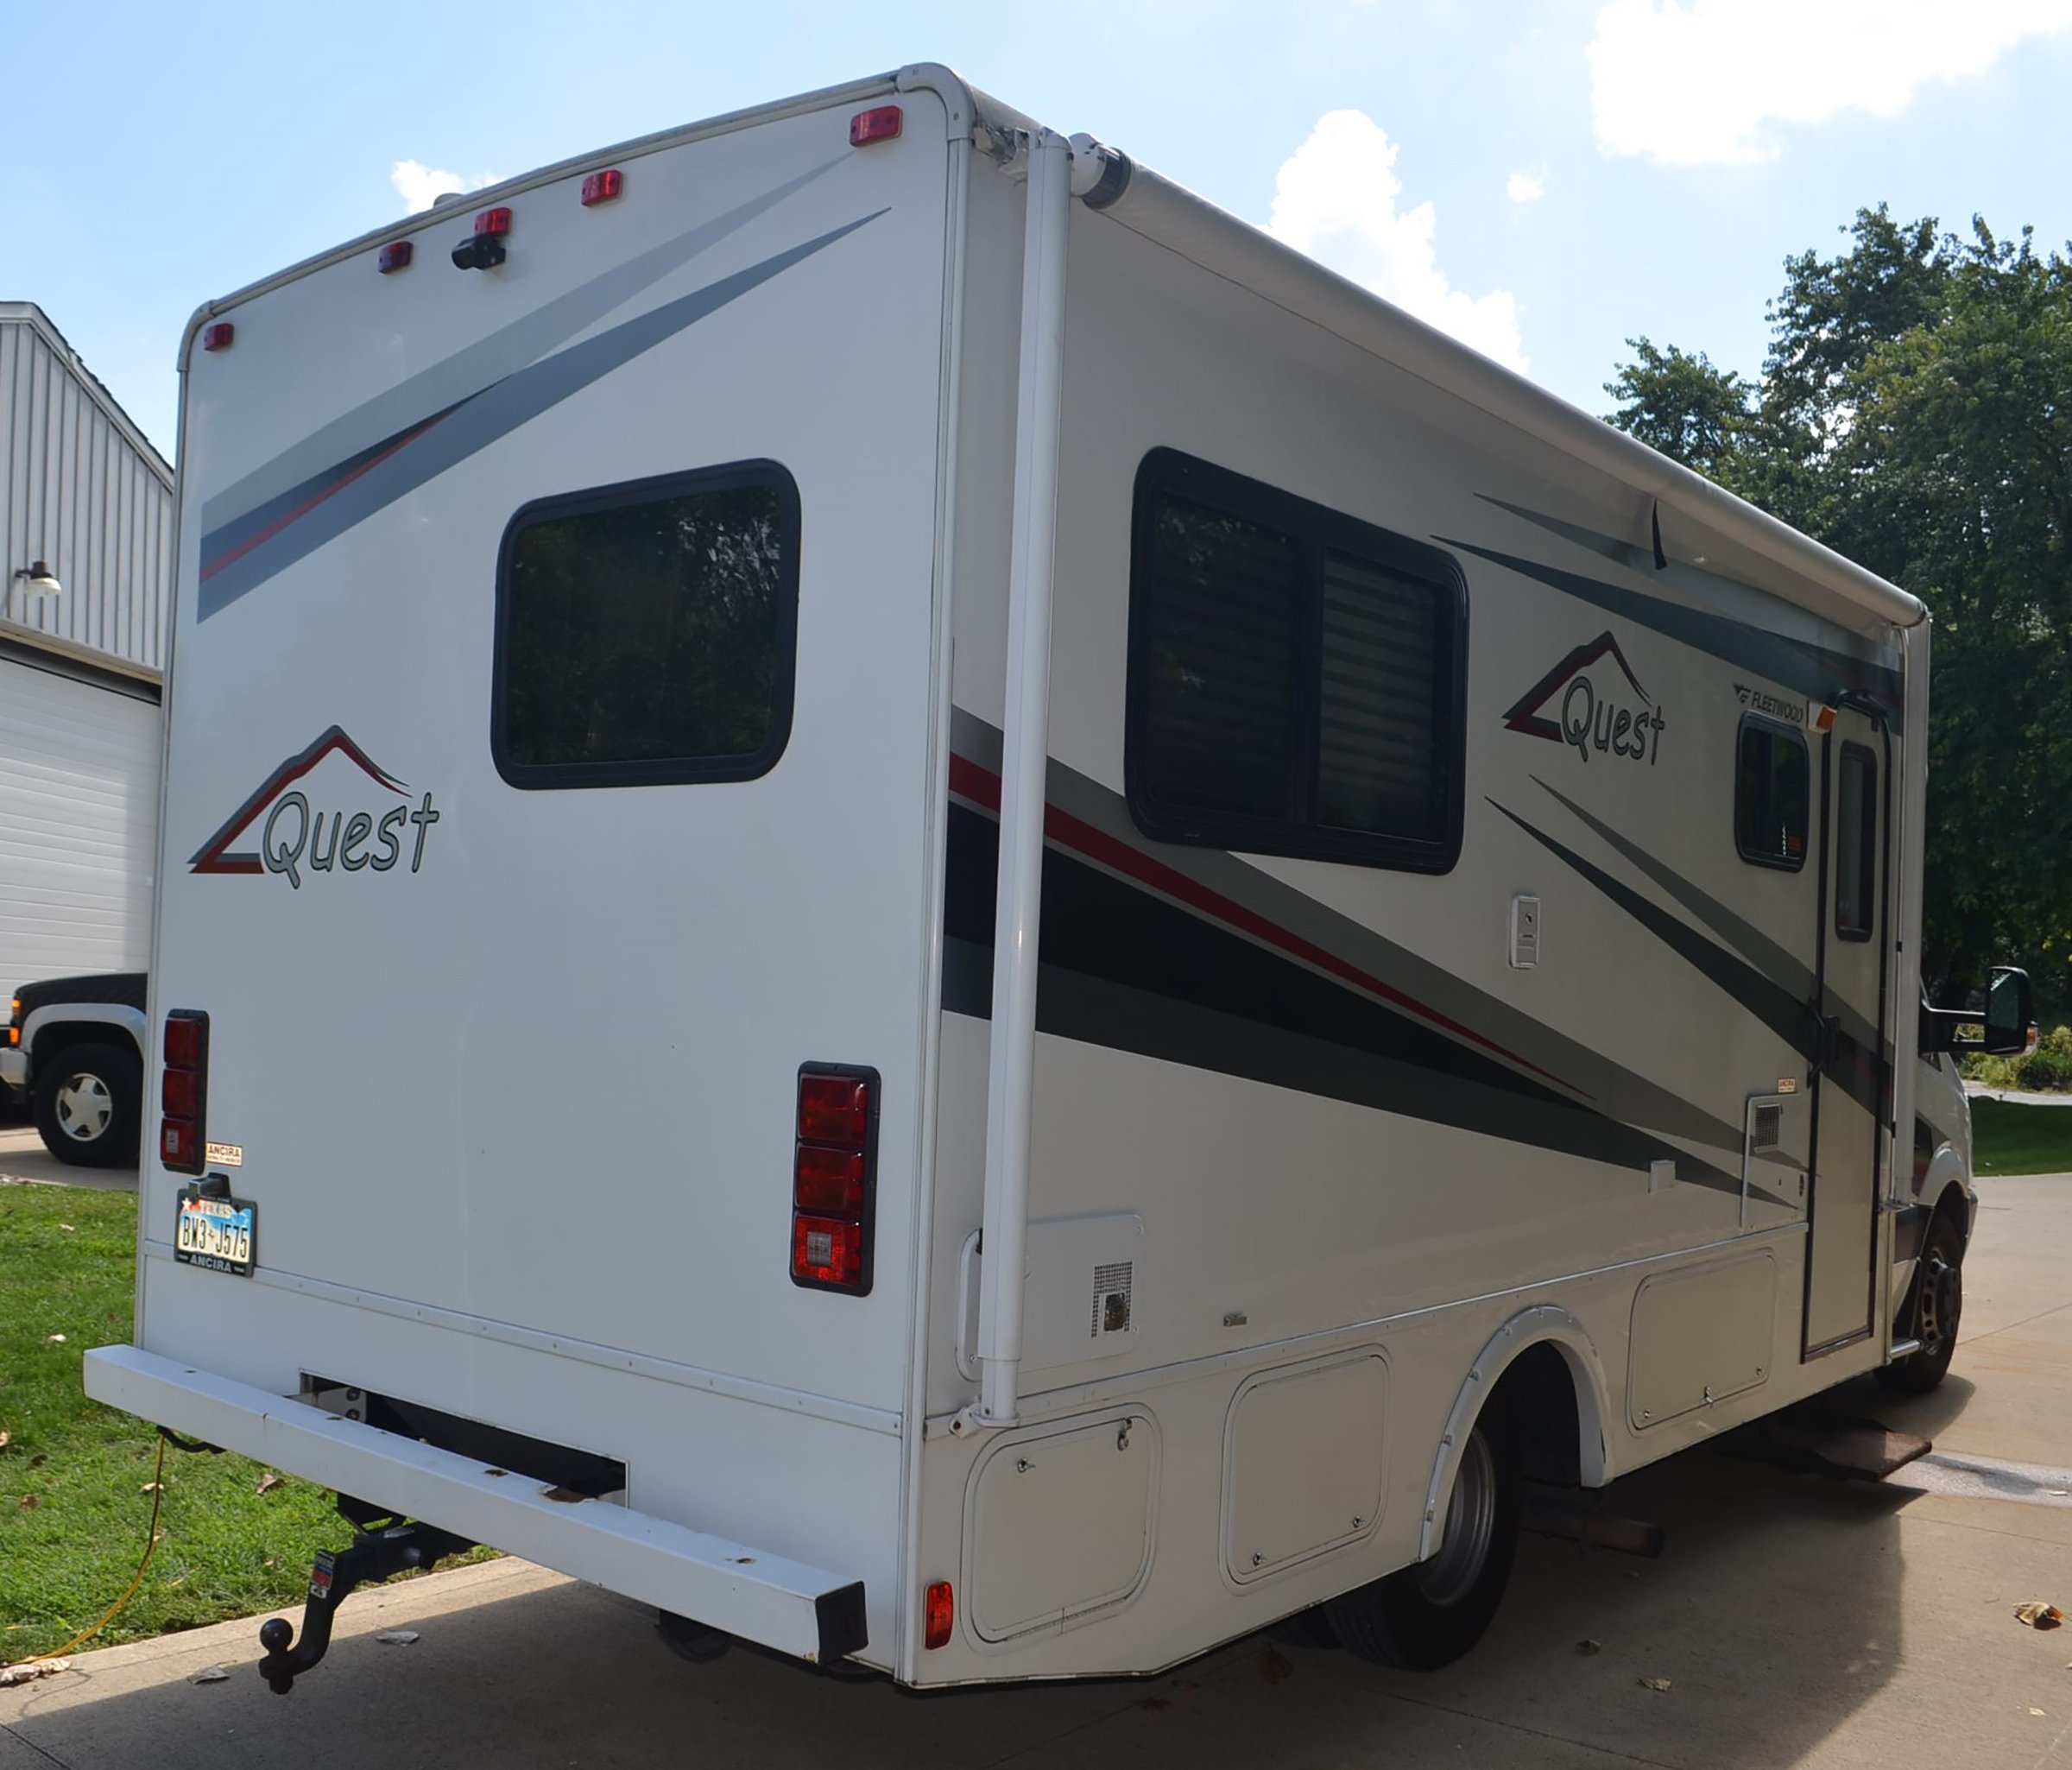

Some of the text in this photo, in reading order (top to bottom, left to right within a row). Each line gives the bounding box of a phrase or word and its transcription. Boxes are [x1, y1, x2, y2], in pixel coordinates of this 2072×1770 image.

[1562, 676, 1665, 766] Quest
[1751, 690, 1804, 723] FLEETWOOD
[262, 791, 439, 889] Quest
[208, 1144, 240, 1157] ANCIRA
[189, 1254, 232, 1273] ANCIRA
